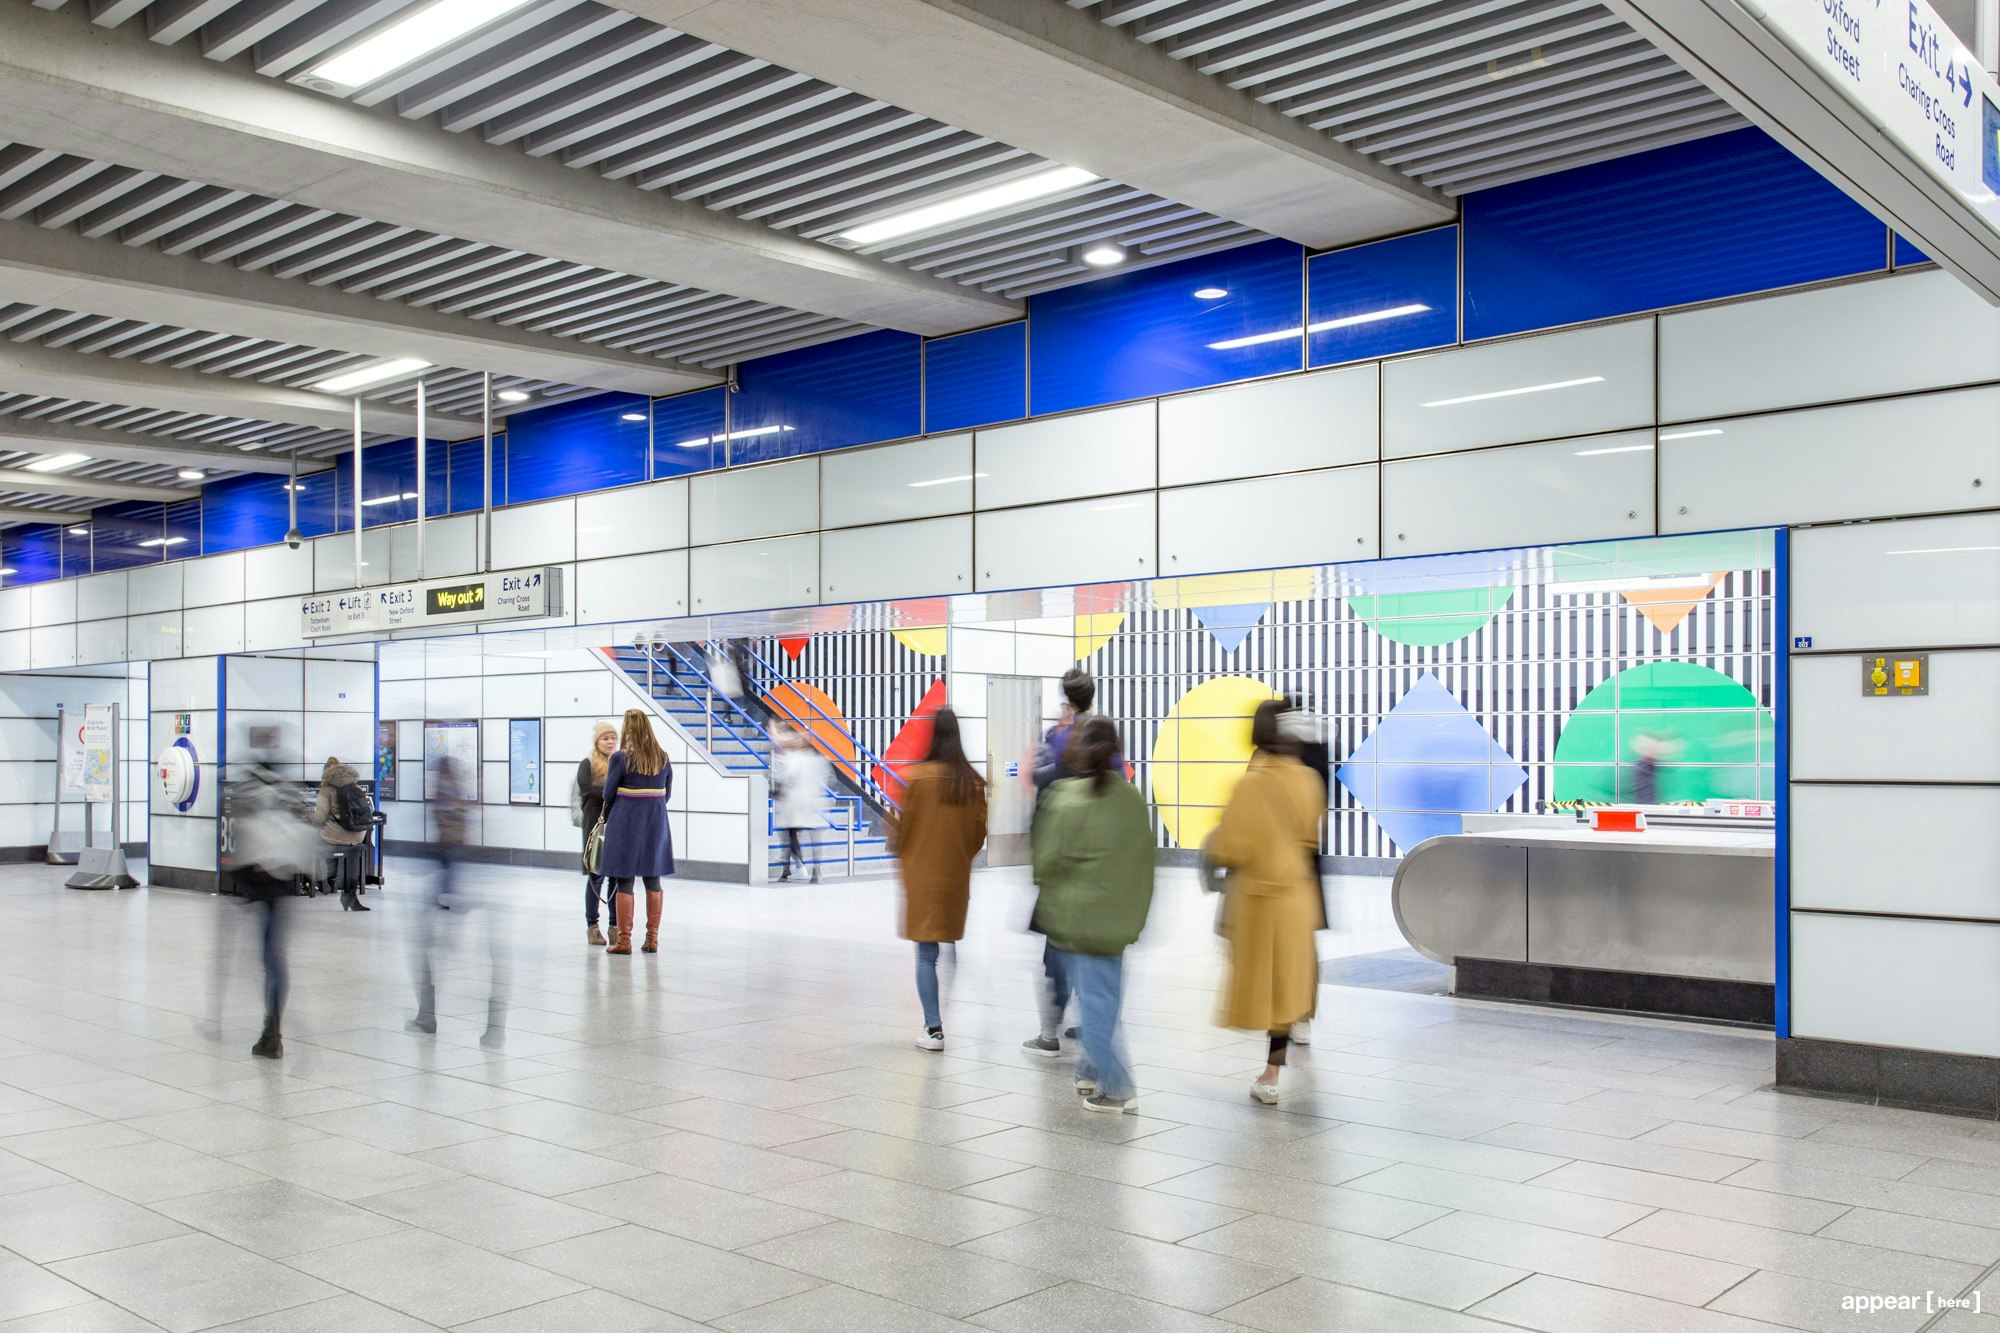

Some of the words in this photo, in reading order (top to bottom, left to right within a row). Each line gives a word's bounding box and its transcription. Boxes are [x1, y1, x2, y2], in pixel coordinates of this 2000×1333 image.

[1908, 0, 1940, 78] Exit
[1945, 58, 1956, 93] 4
[1827, 27, 1861, 82] Street
[1898, 62, 1931, 121] Charing
[1933, 97, 1956, 139] Cross
[1935, 133, 1955, 171] Road
[503, 577, 521, 591] Exit
[524, 576, 531, 589] 4
[347, 596, 361, 609] Lift
[389, 591, 405, 604] Exit
[407, 589, 413, 602] 3
[437, 591, 457, 608] Way
[457, 590, 474, 605] out
[497, 596, 515, 605] Charing
[516, 595, 530, 603] Cross
[310, 601, 325, 613] Exit
[326, 600, 331, 612] 2
[518, 604, 530, 612] Road
[353, 612, 361, 620] Exit
